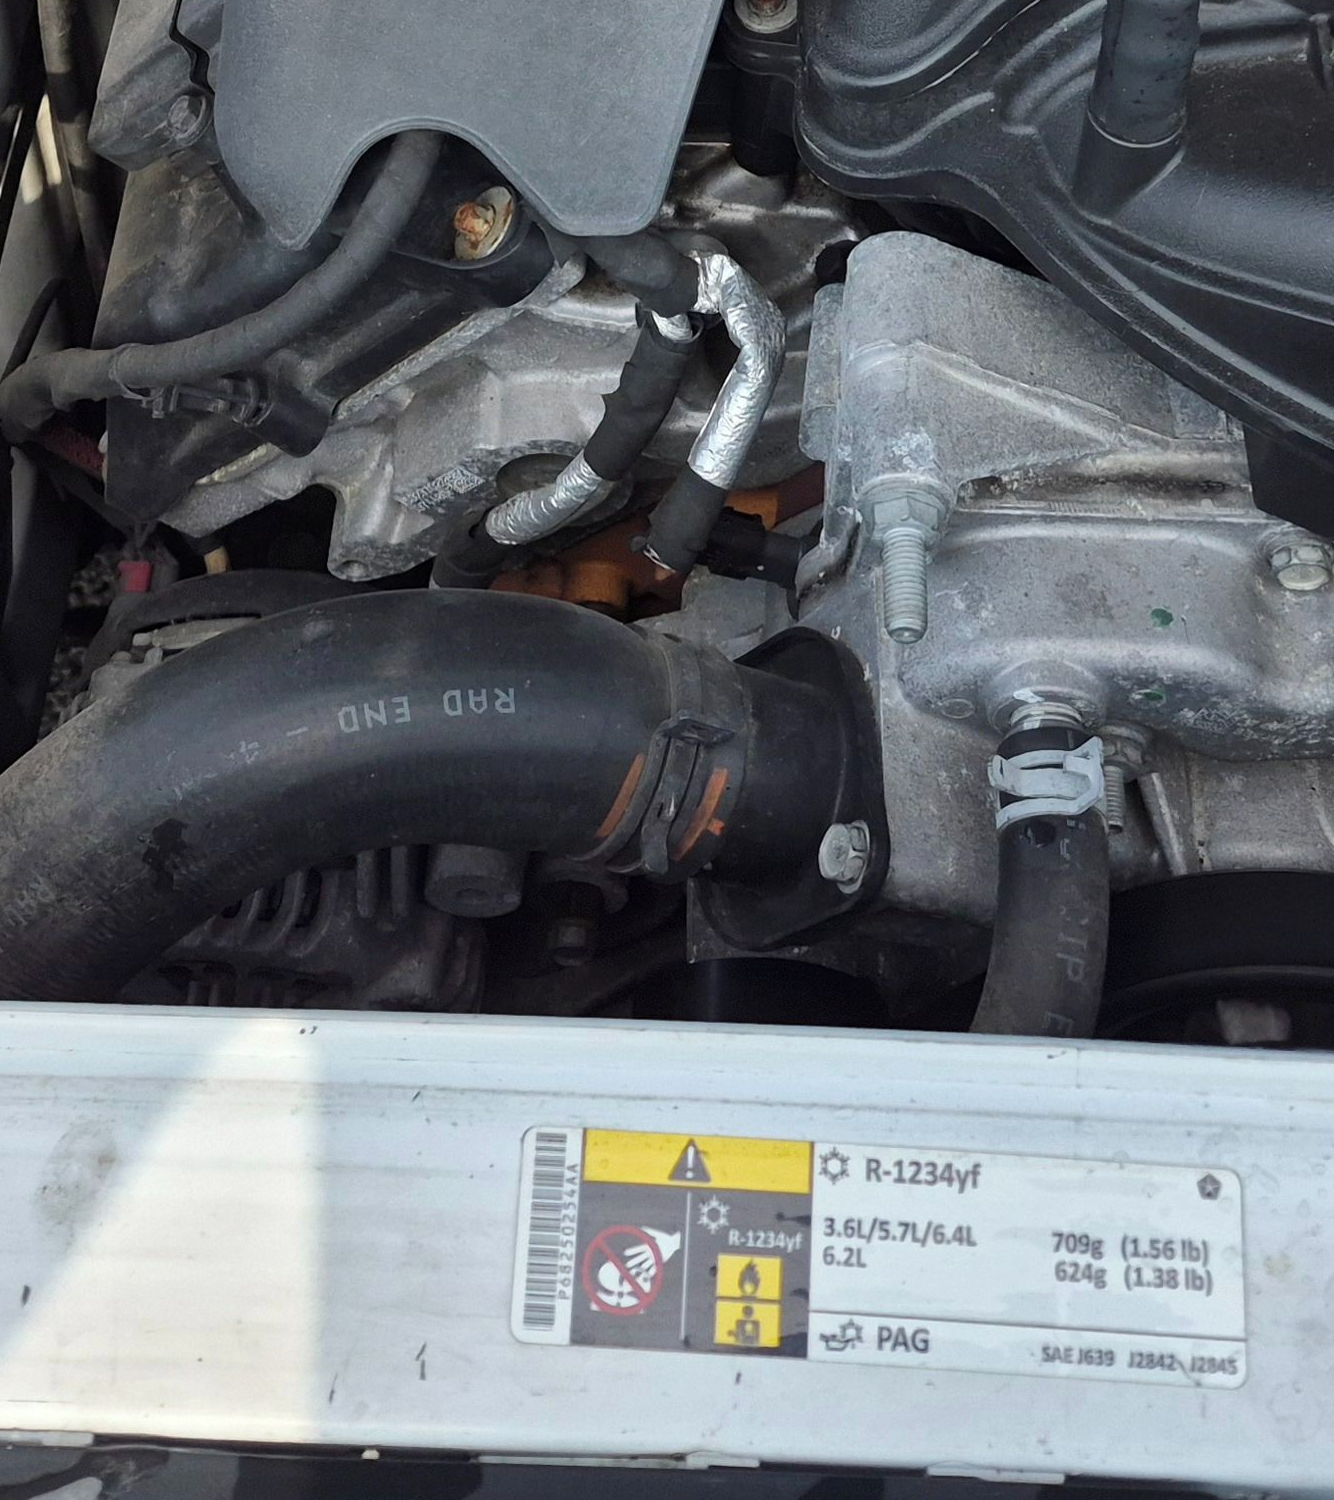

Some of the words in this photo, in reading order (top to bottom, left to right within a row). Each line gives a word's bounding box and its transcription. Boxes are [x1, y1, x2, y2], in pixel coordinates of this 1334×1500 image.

[337, 694, 412, 734] END
[442, 686, 517, 717] RAD
[865, 1157, 982, 1195] R-1234yf
[728, 1229, 803, 1253] R-1234yf
[823, 1216, 978, 1248] 3.6L/5.7L/6.4L
[1052, 1231, 1105, 1261] 709g
[1121, 1233, 1177, 1263] (1.56
[1180, 1238, 1209, 1269] lb)
[822, 1245, 868, 1269] 6.2L
[1054, 1260, 1107, 1290] 624g
[1123, 1263, 1180, 1292] (1.38
[1184, 1268, 1213, 1298] lb)
[876, 1325, 931, 1354] PAG
[1041, 1345, 1074, 1365] SAE
[1077, 1348, 1116, 1368] J639
[1127, 1350, 1178, 1372] J2842
[1189, 1355, 1238, 1376] J2845
